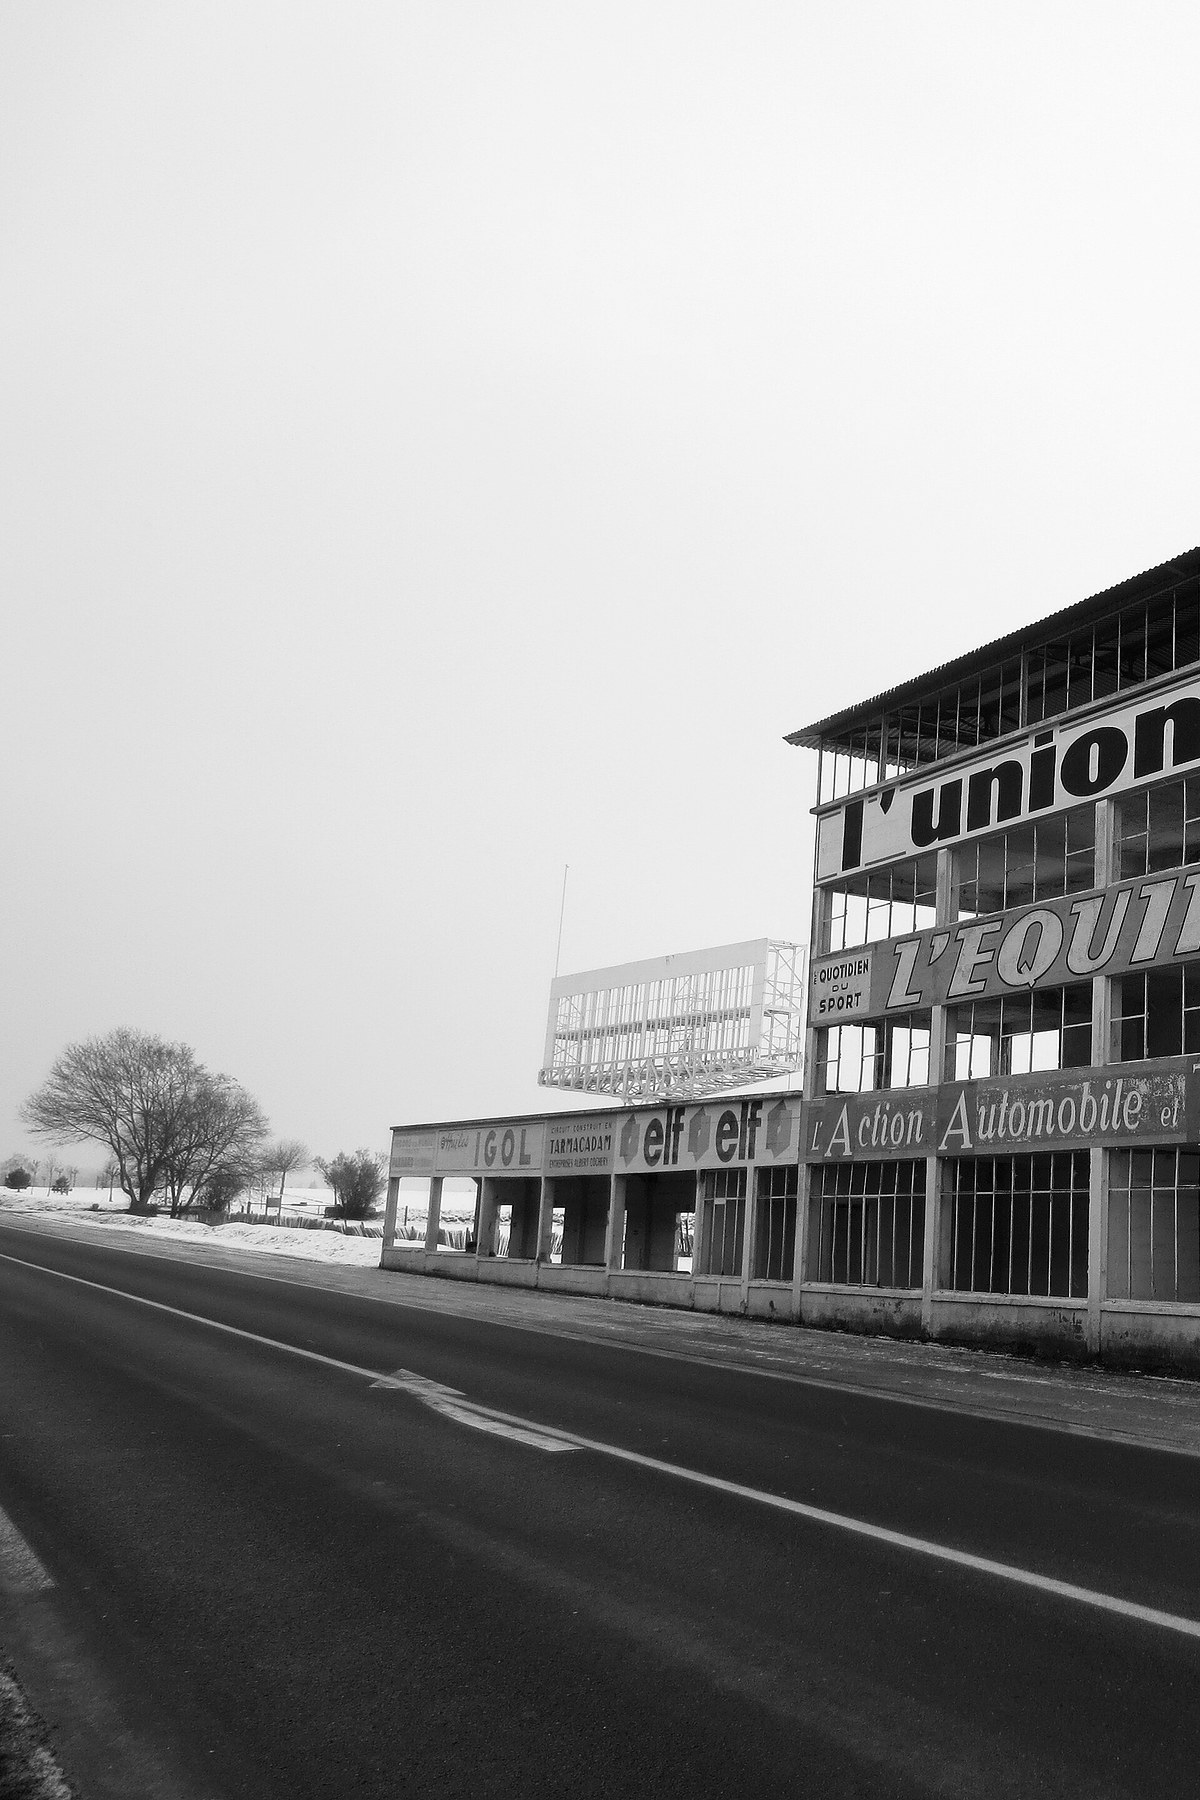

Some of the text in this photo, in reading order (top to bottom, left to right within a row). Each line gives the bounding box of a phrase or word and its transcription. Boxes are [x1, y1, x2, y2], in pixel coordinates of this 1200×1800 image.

[819, 958, 869, 984] QUOTIDIEN
[832, 982, 849, 992] DU
[819, 992, 862, 1014] SPORT
[938, 1078, 1142, 1151] Automobile
[1160, 1100, 1179, 1128] et
[549, 1135, 611, 1154] TARMACADAM
[643, 1100, 763, 1167] elf elf
[474, 1128, 531, 1167] IGOL
